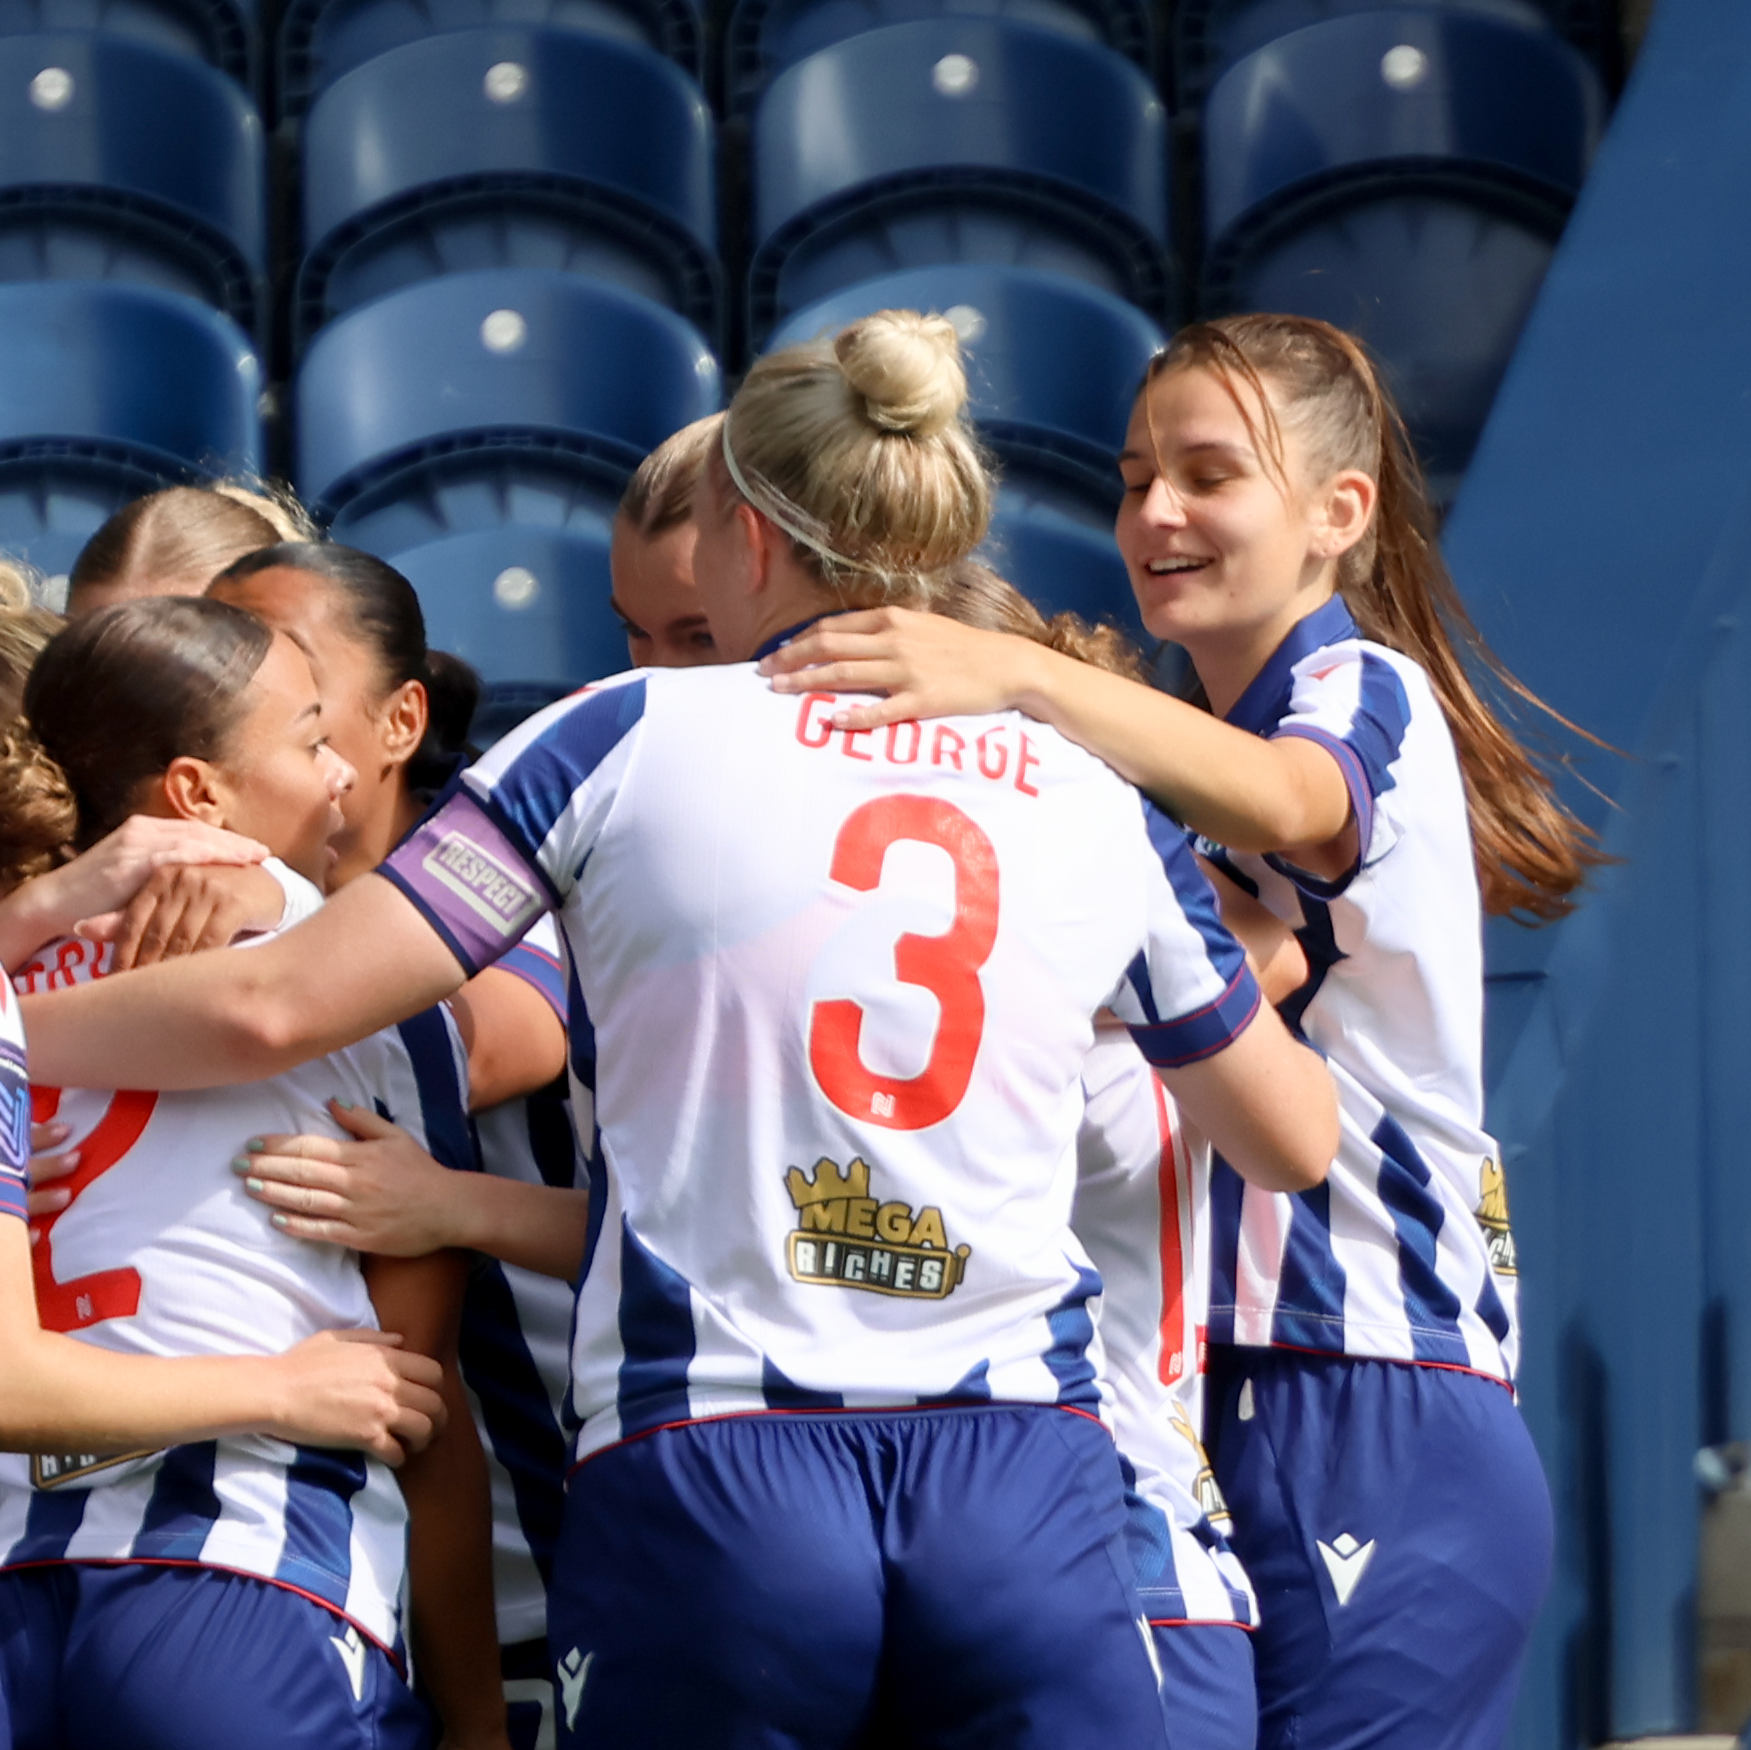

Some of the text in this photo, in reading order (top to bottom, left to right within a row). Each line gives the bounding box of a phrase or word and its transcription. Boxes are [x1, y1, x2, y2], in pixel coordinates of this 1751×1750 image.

[795, 692, 1041, 798] GEORGE
[440, 840, 528, 914] RESPECT
[808, 793, 1000, 1131] 3
[799, 1197, 948, 1249] MEGA
[796, 1241, 944, 1290] RICHES
